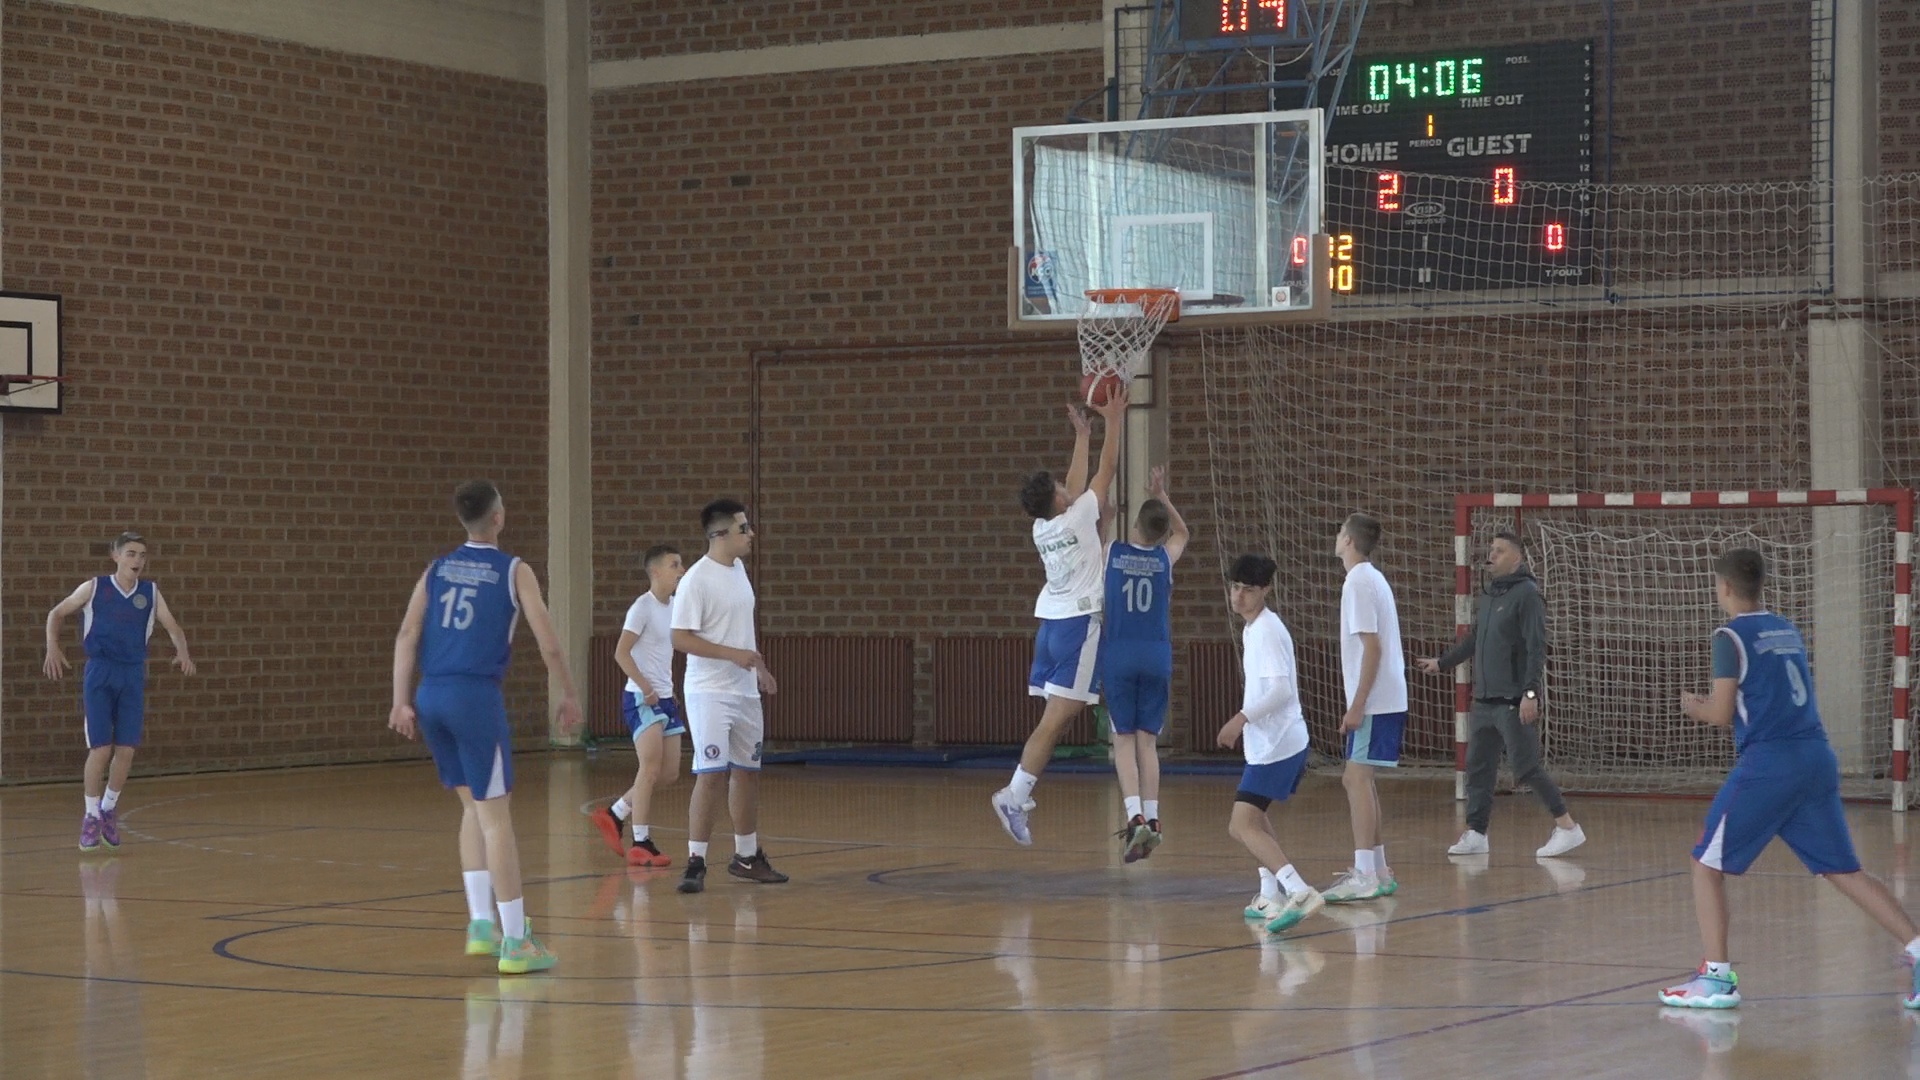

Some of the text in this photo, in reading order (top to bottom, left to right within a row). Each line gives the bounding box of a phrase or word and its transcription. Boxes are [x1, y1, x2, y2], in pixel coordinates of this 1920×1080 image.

[1369, 58, 1483, 101] 04:06
[1335, 102, 1391, 116] IME OUT
[1460, 94, 1524, 108] TIME OUT
[1409, 138, 1443, 148] PERIOD
[1446, 133, 1532, 157] GUEST
[1580, 133, 1590, 142] 10
[1324, 141, 1399, 164] HOME
[1580, 164, 1590, 172] 12
[1379, 174, 1398, 211] 2
[1494, 167, 1513, 204] 0
[1547, 224, 1562, 250] 0
[1122, 577, 1153, 613] 10
[440, 586, 478, 631] 15
[1785, 658, 1808, 707] 9
